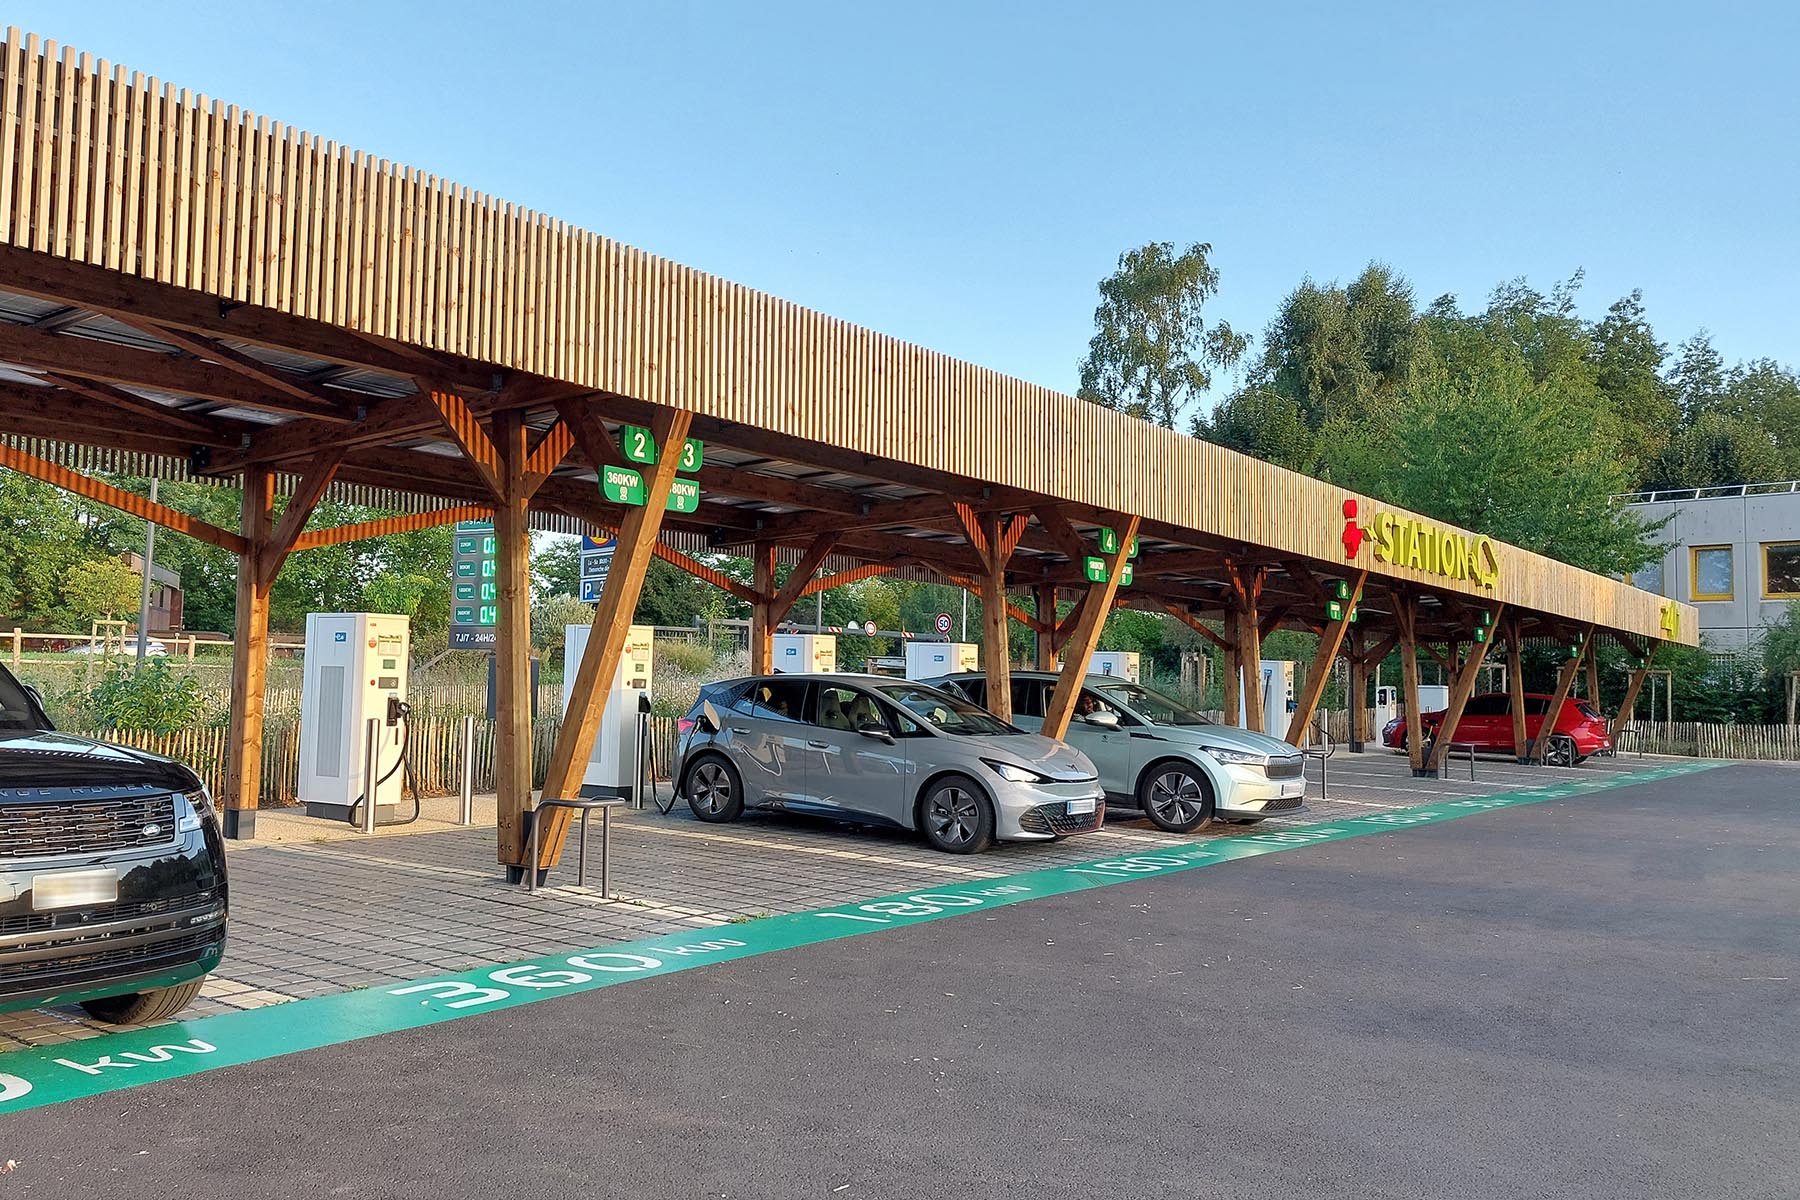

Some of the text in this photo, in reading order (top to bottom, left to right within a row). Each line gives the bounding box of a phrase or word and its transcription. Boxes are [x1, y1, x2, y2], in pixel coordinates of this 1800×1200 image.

[633, 433, 646, 458] 2
[683, 443, 694, 467] 3
[607, 472, 638, 487] 360KW
[669, 482, 696, 497] 80KW
[1106, 533, 1113, 551] 4
[584, 582, 592, 599] P
[1341, 583, 1347, 597] 6
[938, 619, 949, 628] 50
[1064, 856, 1189, 876] 180
[814, 894, 984, 923] 180
[386, 952, 663, 1009] 360
